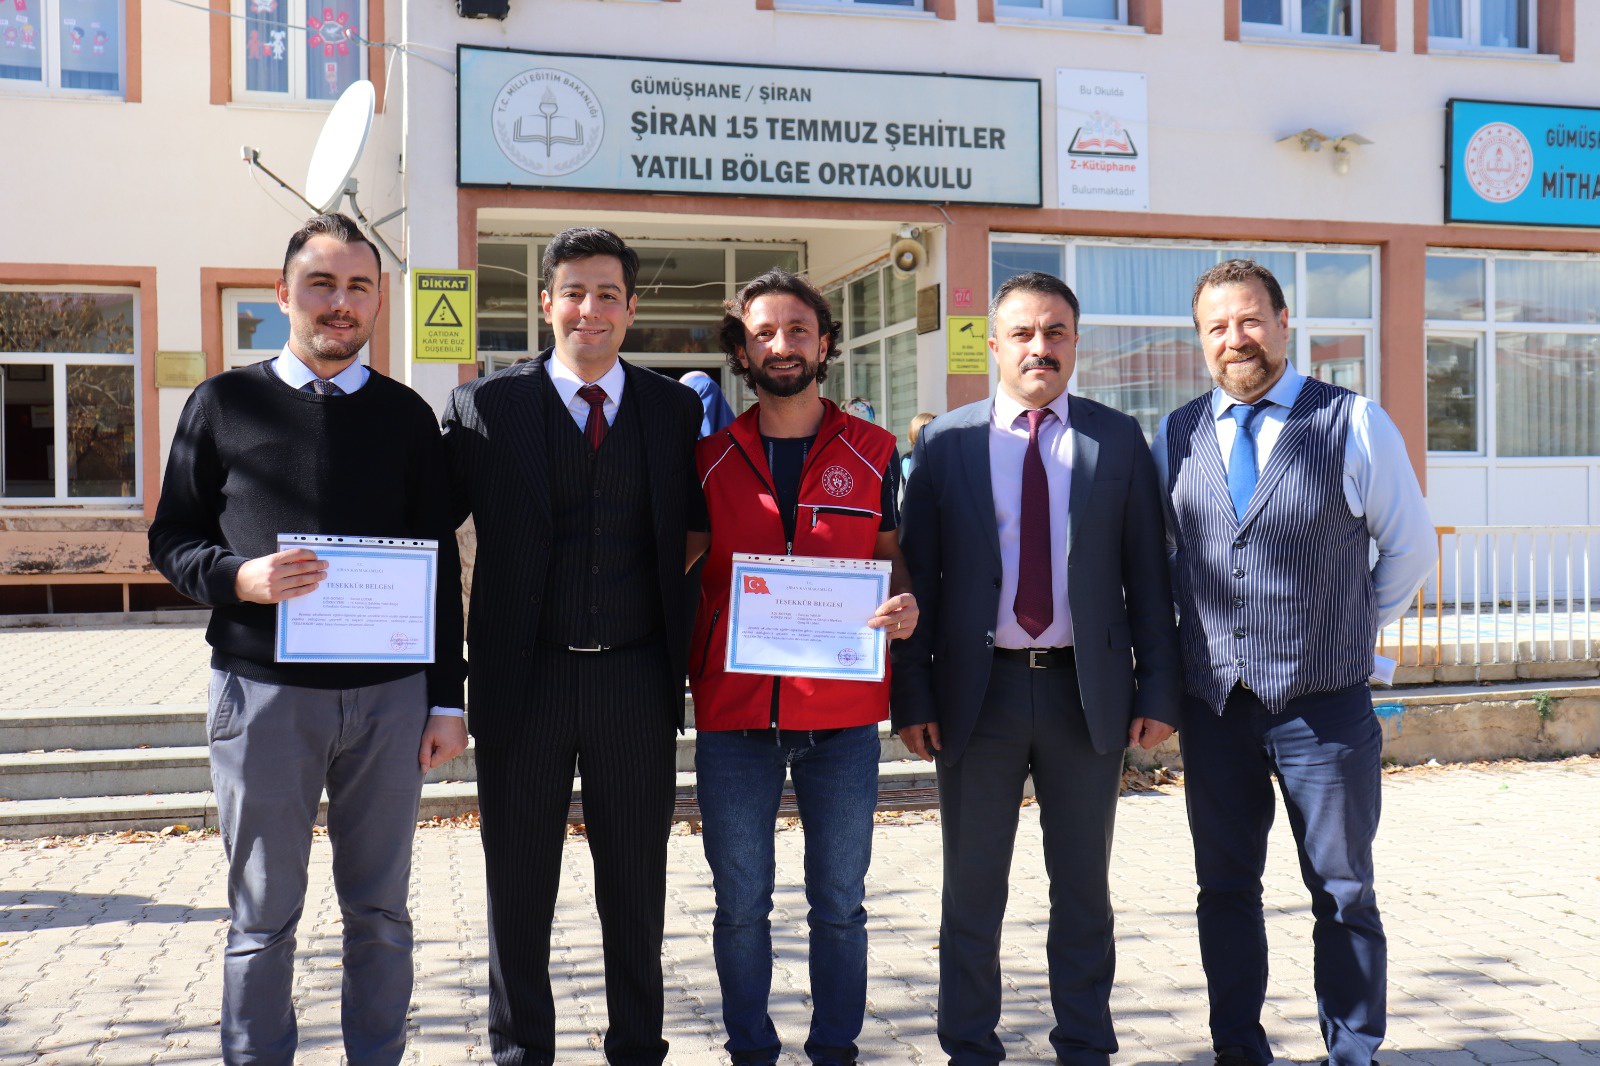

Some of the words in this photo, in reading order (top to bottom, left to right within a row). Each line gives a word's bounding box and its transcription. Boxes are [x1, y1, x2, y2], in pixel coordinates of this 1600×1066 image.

[507, 76, 529, 97] MİLLİ
[529, 71, 562, 83] EĞİTİM
[563, 78, 599, 119] BAKANLIĞI
[630, 76, 742, 101] GÜMÜŞHANE
[758, 83, 812, 105] ŞİRAN
[1080, 85, 1092, 95] Bu
[1094, 86, 1125, 97] Okulda
[630, 105, 717, 141] ŞİRAN
[726, 116, 758, 140] 15
[766, 118, 878, 145] TEMMUZ
[884, 118, 1006, 152] ŞEHİTLER
[630, 155, 712, 181] YATILI
[721, 153, 810, 184] BÖLGE
[818, 163, 973, 190] ORTAOKULU
[1070, 159, 1136, 173] Z-Kütüphane
[1072, 185, 1136, 197] Bulunmaktadır
[421, 278, 466, 289] DİKKAT
[428, 330, 459, 338] ÇATIDAN
[425, 345, 463, 353] DÜŞEBİLİR
[327, 582, 364, 590] TEŞEKKÜR
[775, 598, 812, 607] TEŞEKKÜR
[814, 600, 843, 608] BELGESİ
